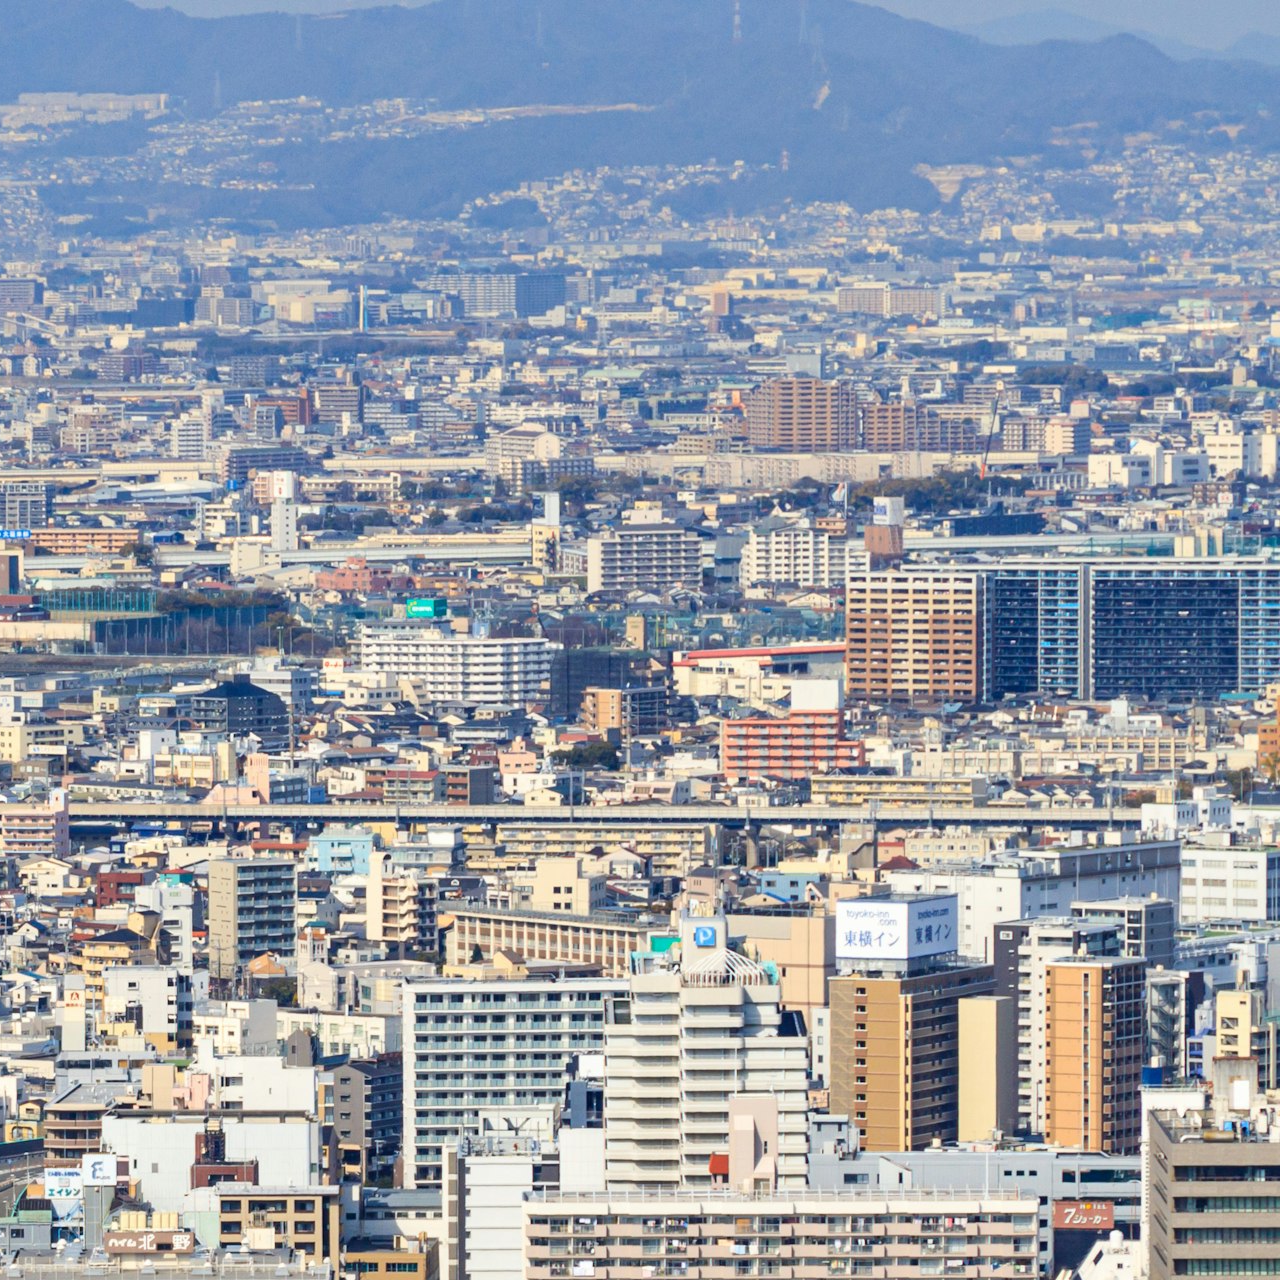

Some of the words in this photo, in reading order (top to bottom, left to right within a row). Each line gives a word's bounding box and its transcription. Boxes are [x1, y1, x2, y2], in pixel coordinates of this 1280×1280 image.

[846, 909, 890, 920] toyoko-inn
[844, 929, 901, 948] 東横イン
[914, 922, 952, 946] 東横イン
[48, 1188, 81, 1197] エイシン
